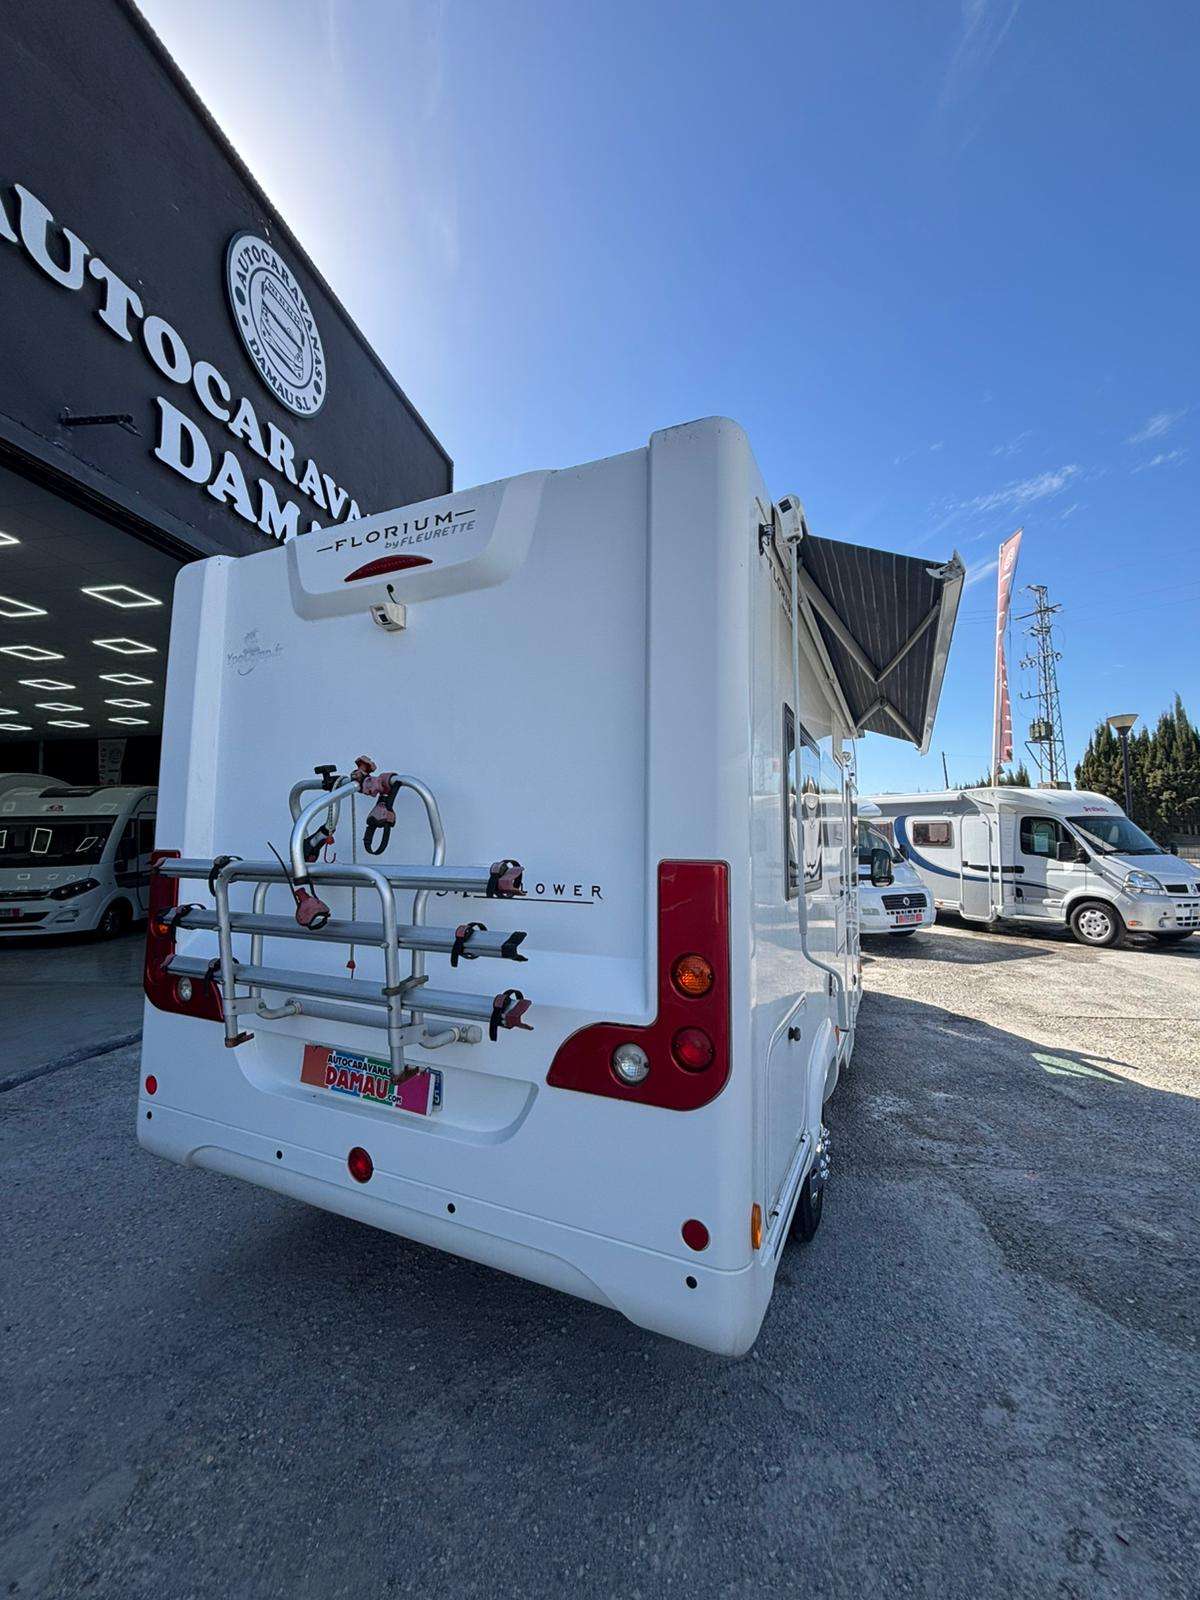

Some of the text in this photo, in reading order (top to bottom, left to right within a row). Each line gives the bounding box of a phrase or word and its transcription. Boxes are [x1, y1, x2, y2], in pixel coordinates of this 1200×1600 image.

[236, 244, 323, 383] AUTOCARAVANAS
[0, 183, 371, 524] UTOCARAV
[248, 337, 294, 407] DAMAU
[335, 510, 454, 552] FLORIUM
[399, 519, 476, 548] FLEURETTE
[325, 1065, 389, 1099] DAMAU
